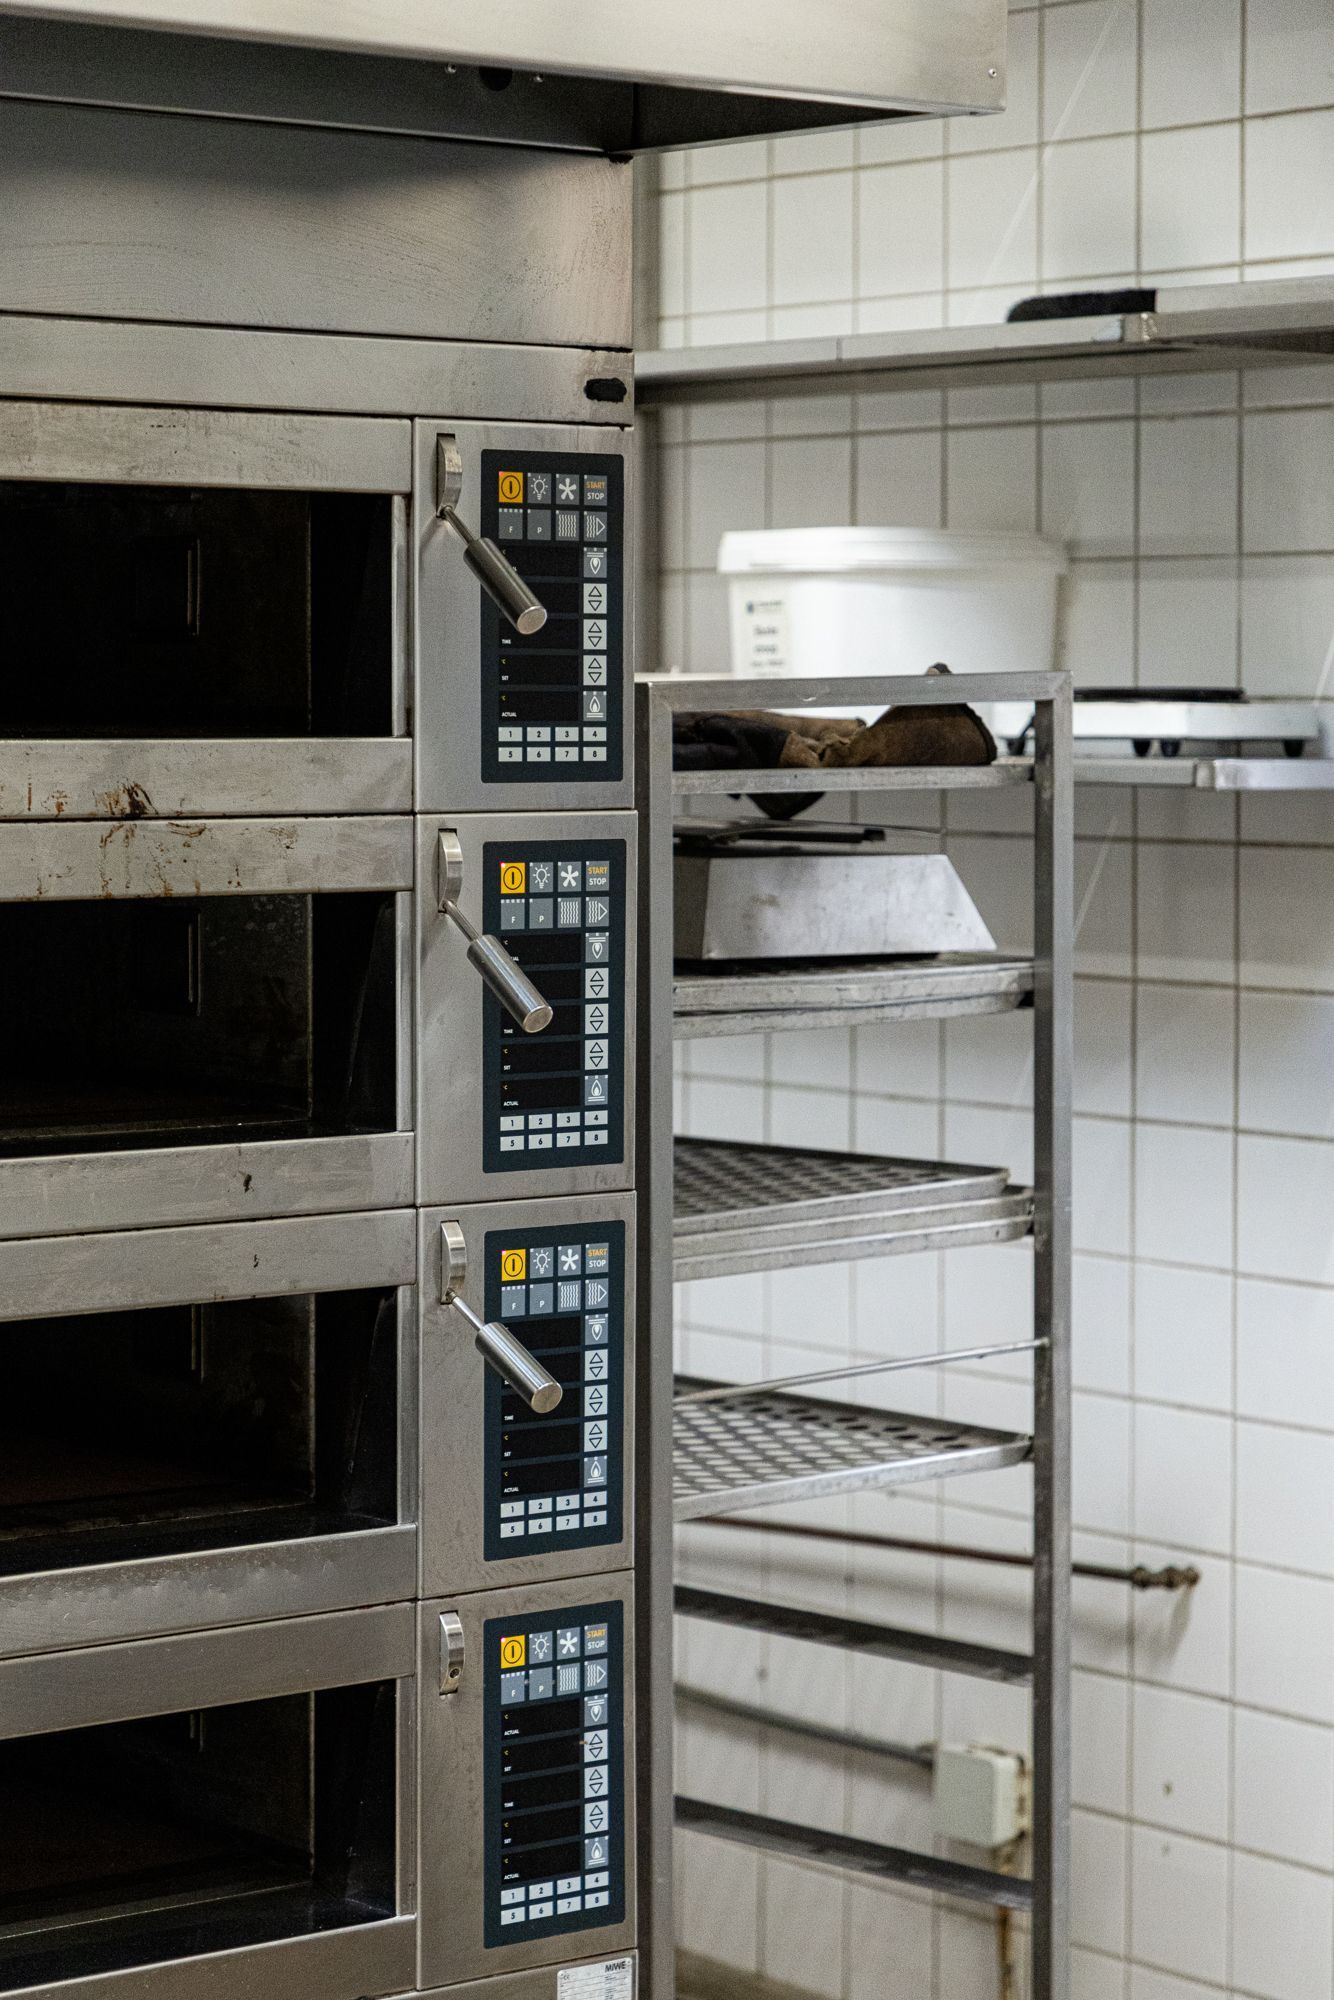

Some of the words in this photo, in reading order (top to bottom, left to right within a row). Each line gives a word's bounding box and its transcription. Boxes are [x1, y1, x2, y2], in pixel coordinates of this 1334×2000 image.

[588, 1249, 607, 1257] START
[587, 1629, 606, 1638] START
[588, 1641, 605, 1649] STOP
